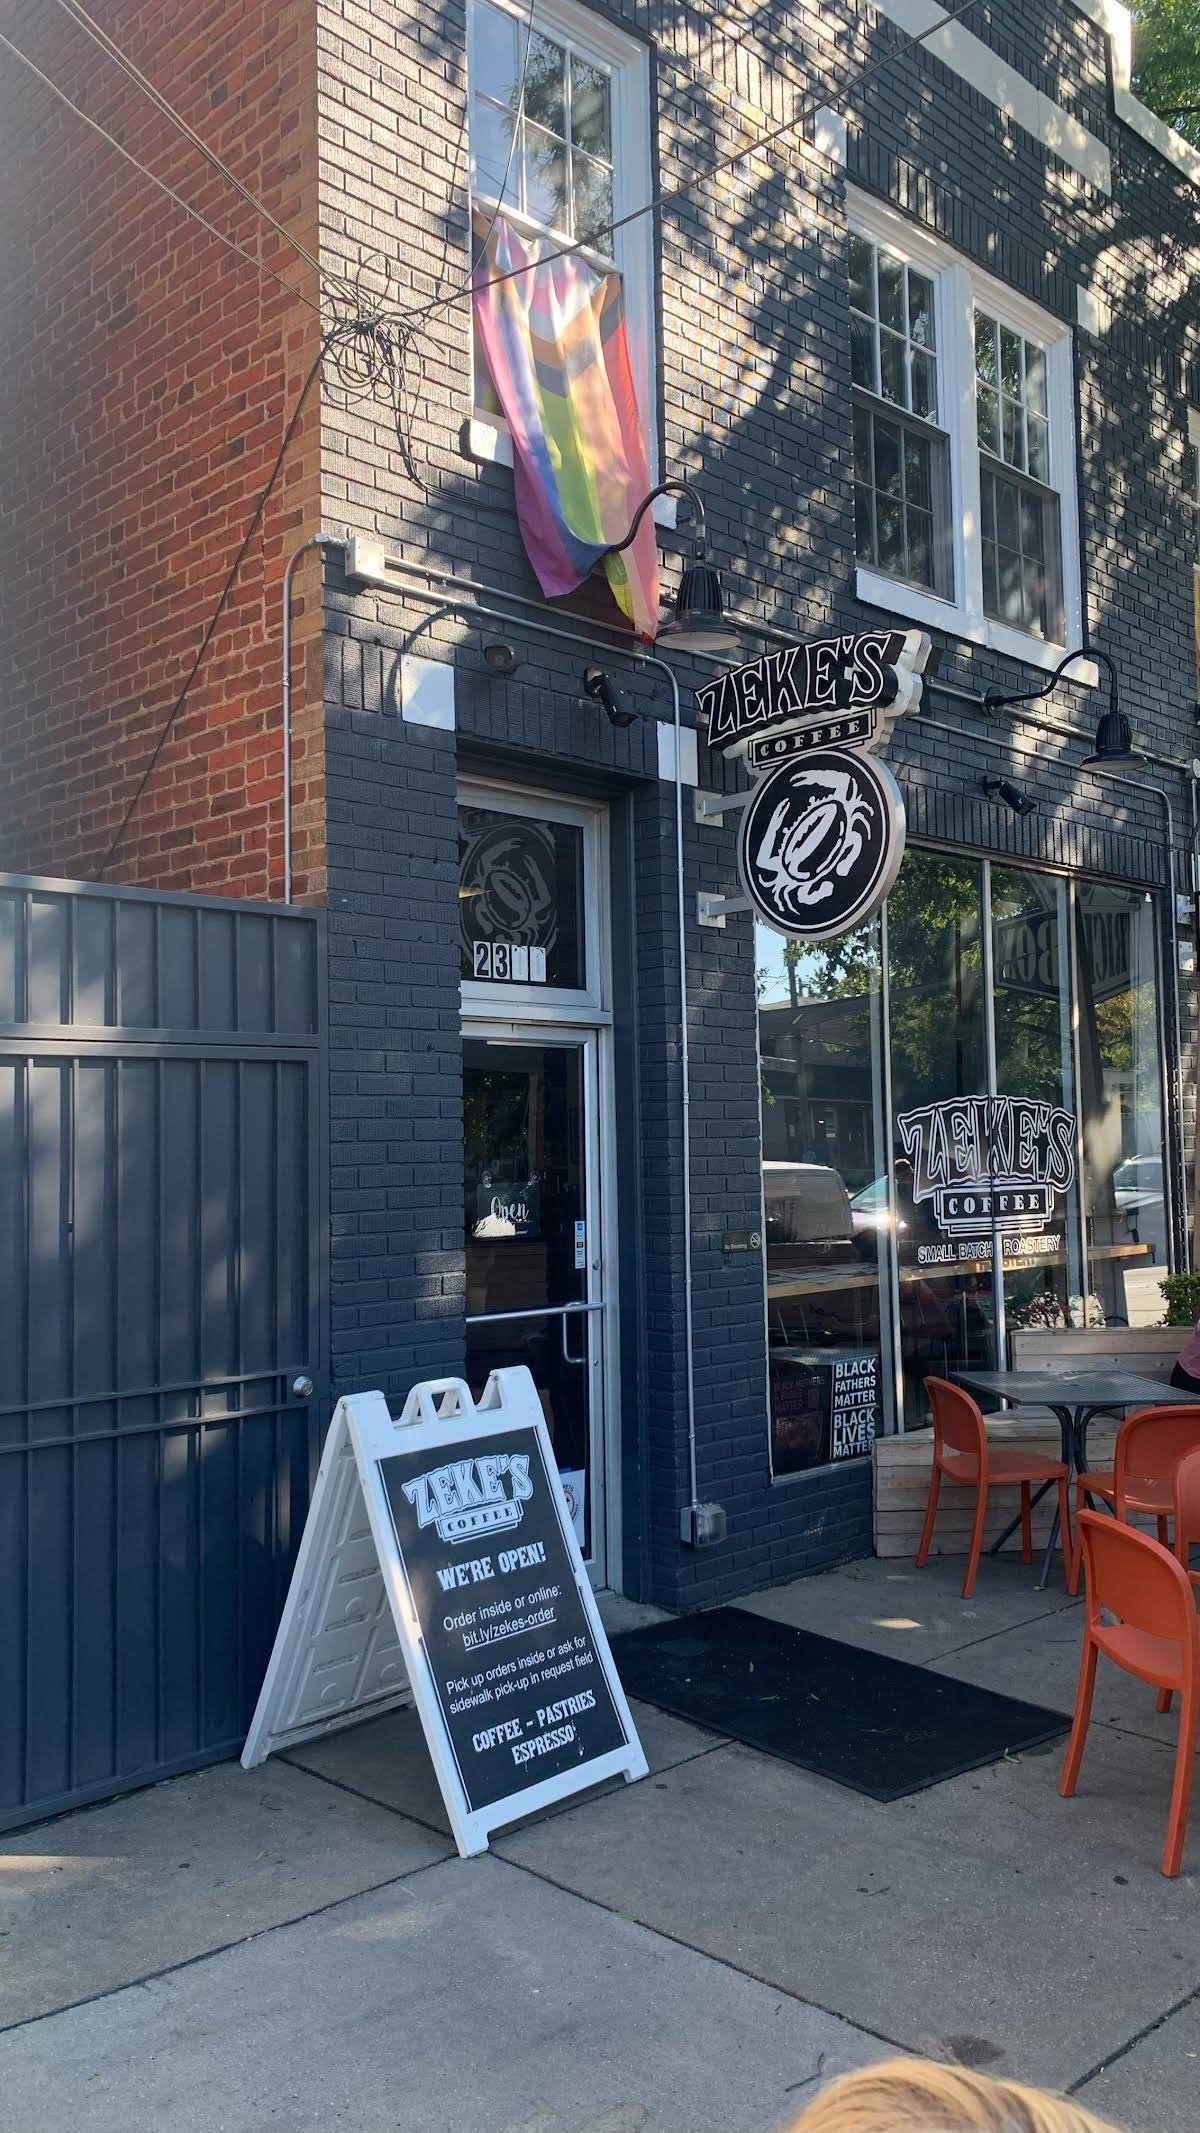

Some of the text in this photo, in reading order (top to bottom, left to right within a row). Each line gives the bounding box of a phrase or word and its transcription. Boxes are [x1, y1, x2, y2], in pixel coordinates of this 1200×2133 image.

[695, 632, 895, 747] ZEKE'S
[760, 720, 861, 757] COFFEE
[897, 1094, 1076, 1204] ZEKE'S
[490, 1196, 529, 1221] Open
[949, 1194, 1040, 1215] COFFEE
[917, 1244, 956, 1263] SMALL
[959, 1241, 993, 1260] BATCH
[1003, 1235, 1061, 1256] ROASTERY
[835, 1358, 876, 1378] BLACK
[835, 1375, 876, 1393] FATHERS
[834, 1389, 875, 1408] MATTER
[833, 1422, 875, 1446] LIVES
[834, 1408, 875, 1429] BLACK
[401, 1454, 534, 1529] ZEKE'S
[447, 1507, 513, 1532] COFFEE
[436, 1541, 547, 1591] WE'RE OPEN!
[443, 1585, 562, 1631] Order inside or online:
[462, 1606, 555, 1648] bit.ly/zekes-order
[446, 1636, 586, 1695] Pick up orders inside or ask for
[449, 1651, 594, 1714] sidewalk pick-up in request field
[472, 1718, 523, 1752] COFFEE
[536, 1689, 597, 1727] PASTRIES
[511, 1724, 575, 1765] ESPRESSO
